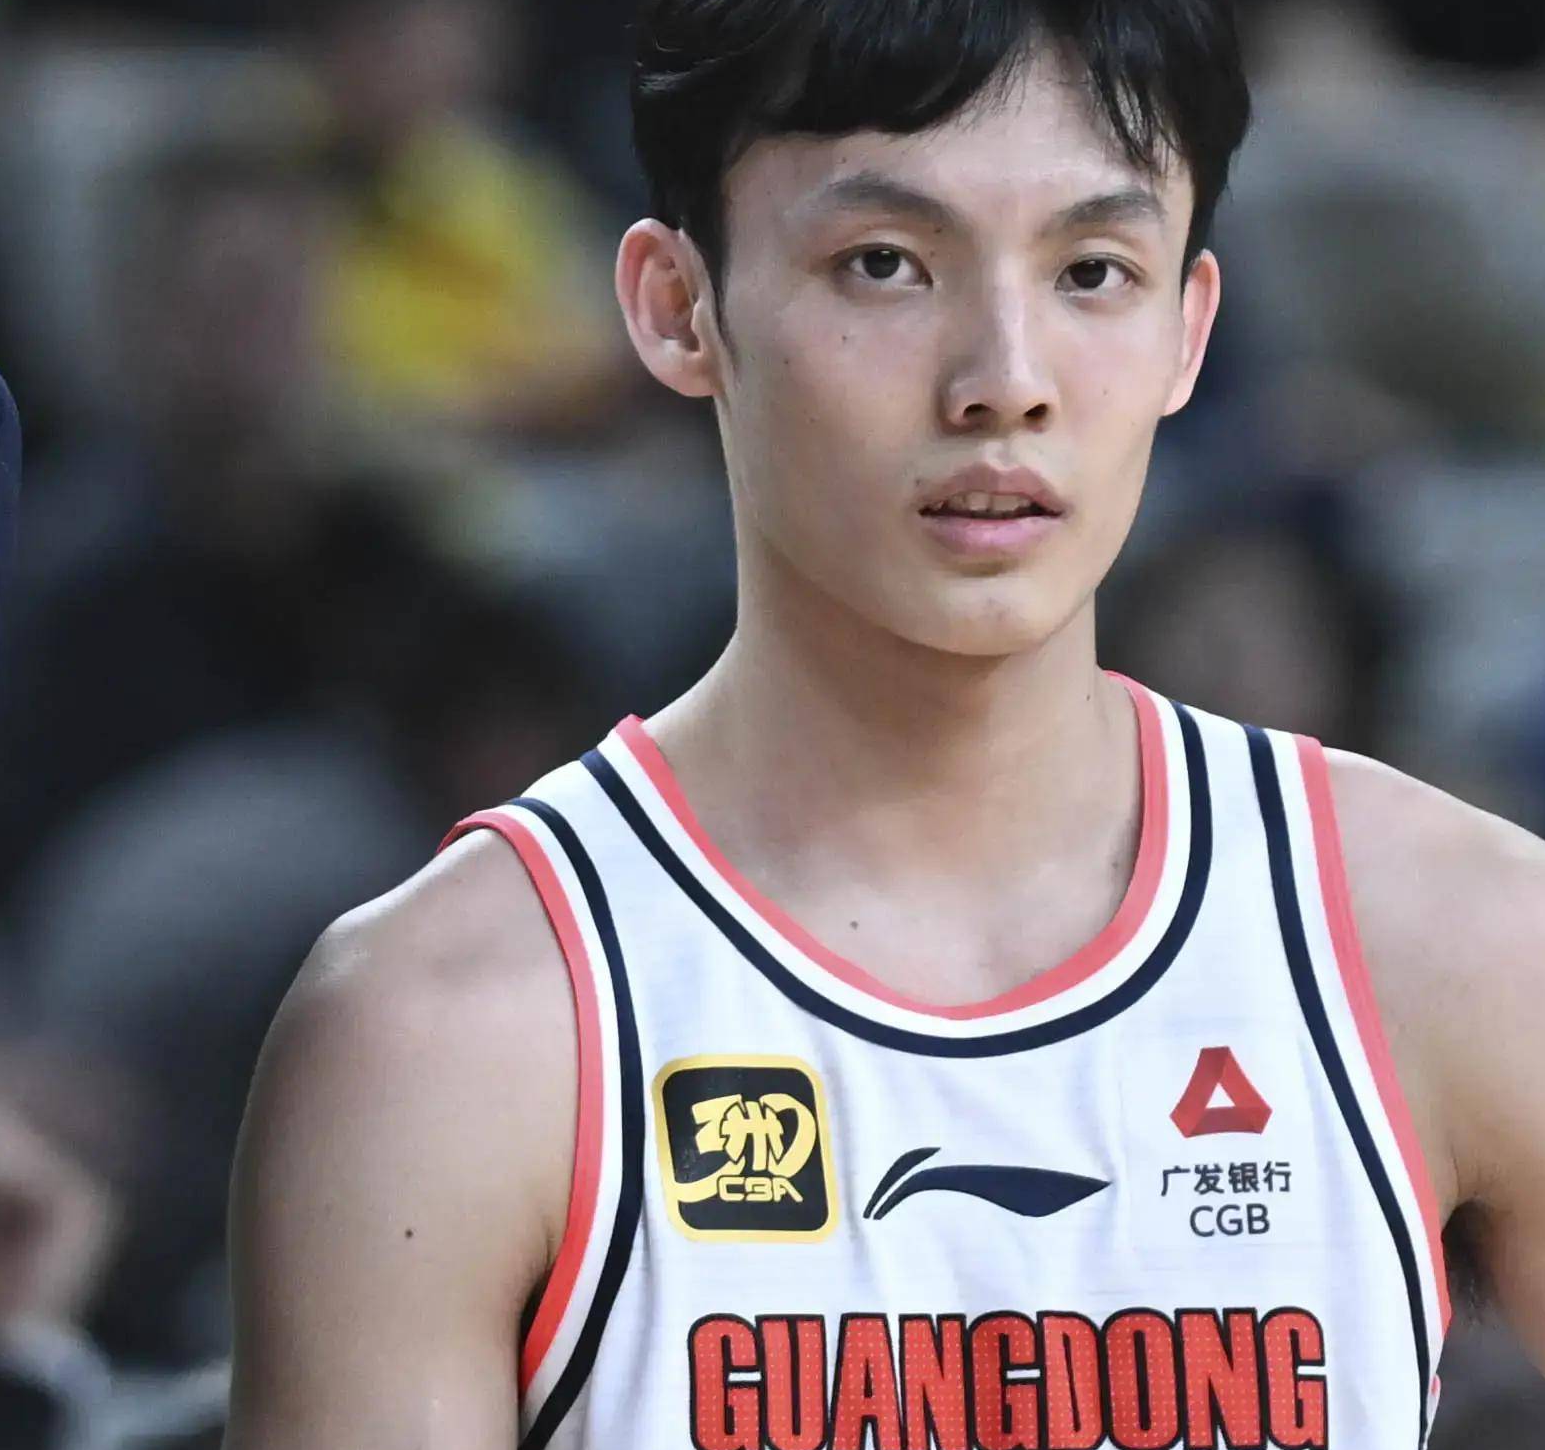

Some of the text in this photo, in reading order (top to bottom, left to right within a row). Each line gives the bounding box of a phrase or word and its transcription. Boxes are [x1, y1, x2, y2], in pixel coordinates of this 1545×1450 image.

[717, 1176, 804, 1203] CBA
[1161, 1161, 1292, 1197] 广发银行
[1189, 1203, 1271, 1237] CGB
